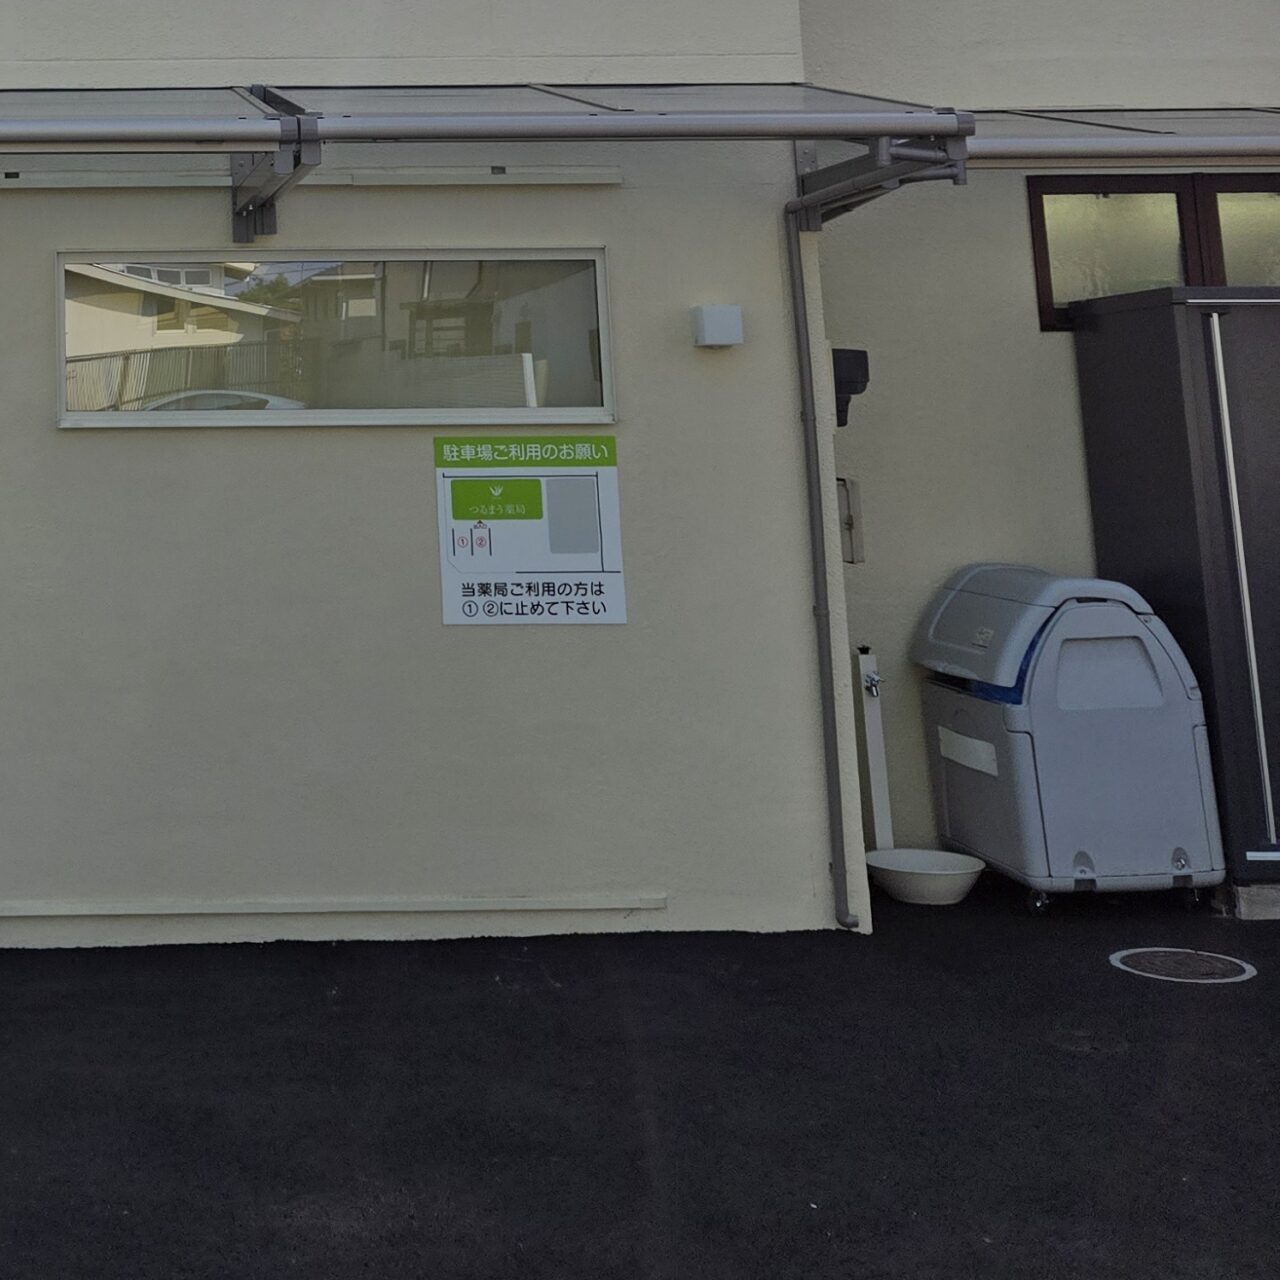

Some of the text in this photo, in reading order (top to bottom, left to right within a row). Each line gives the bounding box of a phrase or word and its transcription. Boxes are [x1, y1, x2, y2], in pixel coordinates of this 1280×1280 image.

[443, 443, 609, 462] 駐車場ご利用のお願い
[461, 581, 605, 598] 当薬局ご利用の方は
